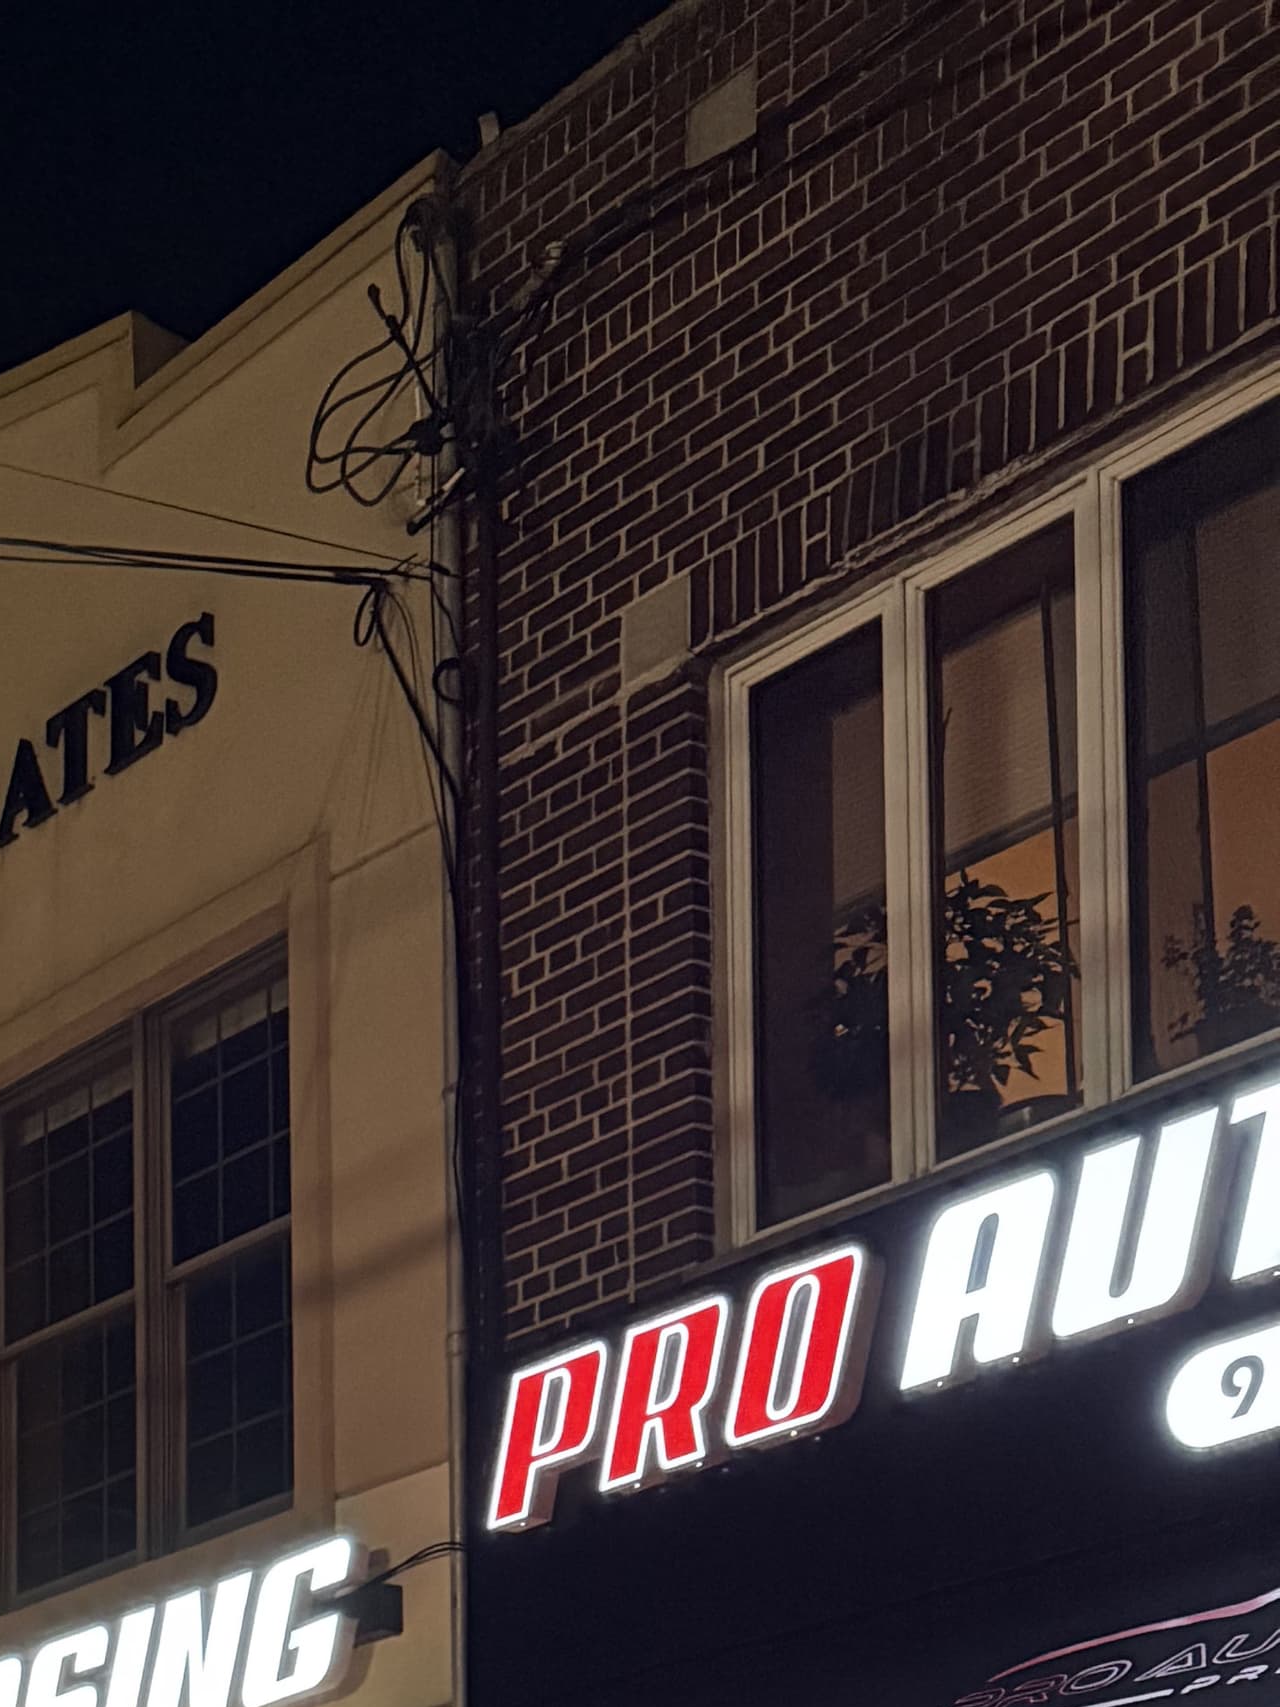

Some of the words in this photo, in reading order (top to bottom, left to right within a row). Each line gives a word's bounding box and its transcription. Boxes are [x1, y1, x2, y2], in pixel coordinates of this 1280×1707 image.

[488, 1243, 865, 1531] PRO
[1220, 1355, 1264, 1419] 9
[1180, 1665, 1280, 1694] PR
